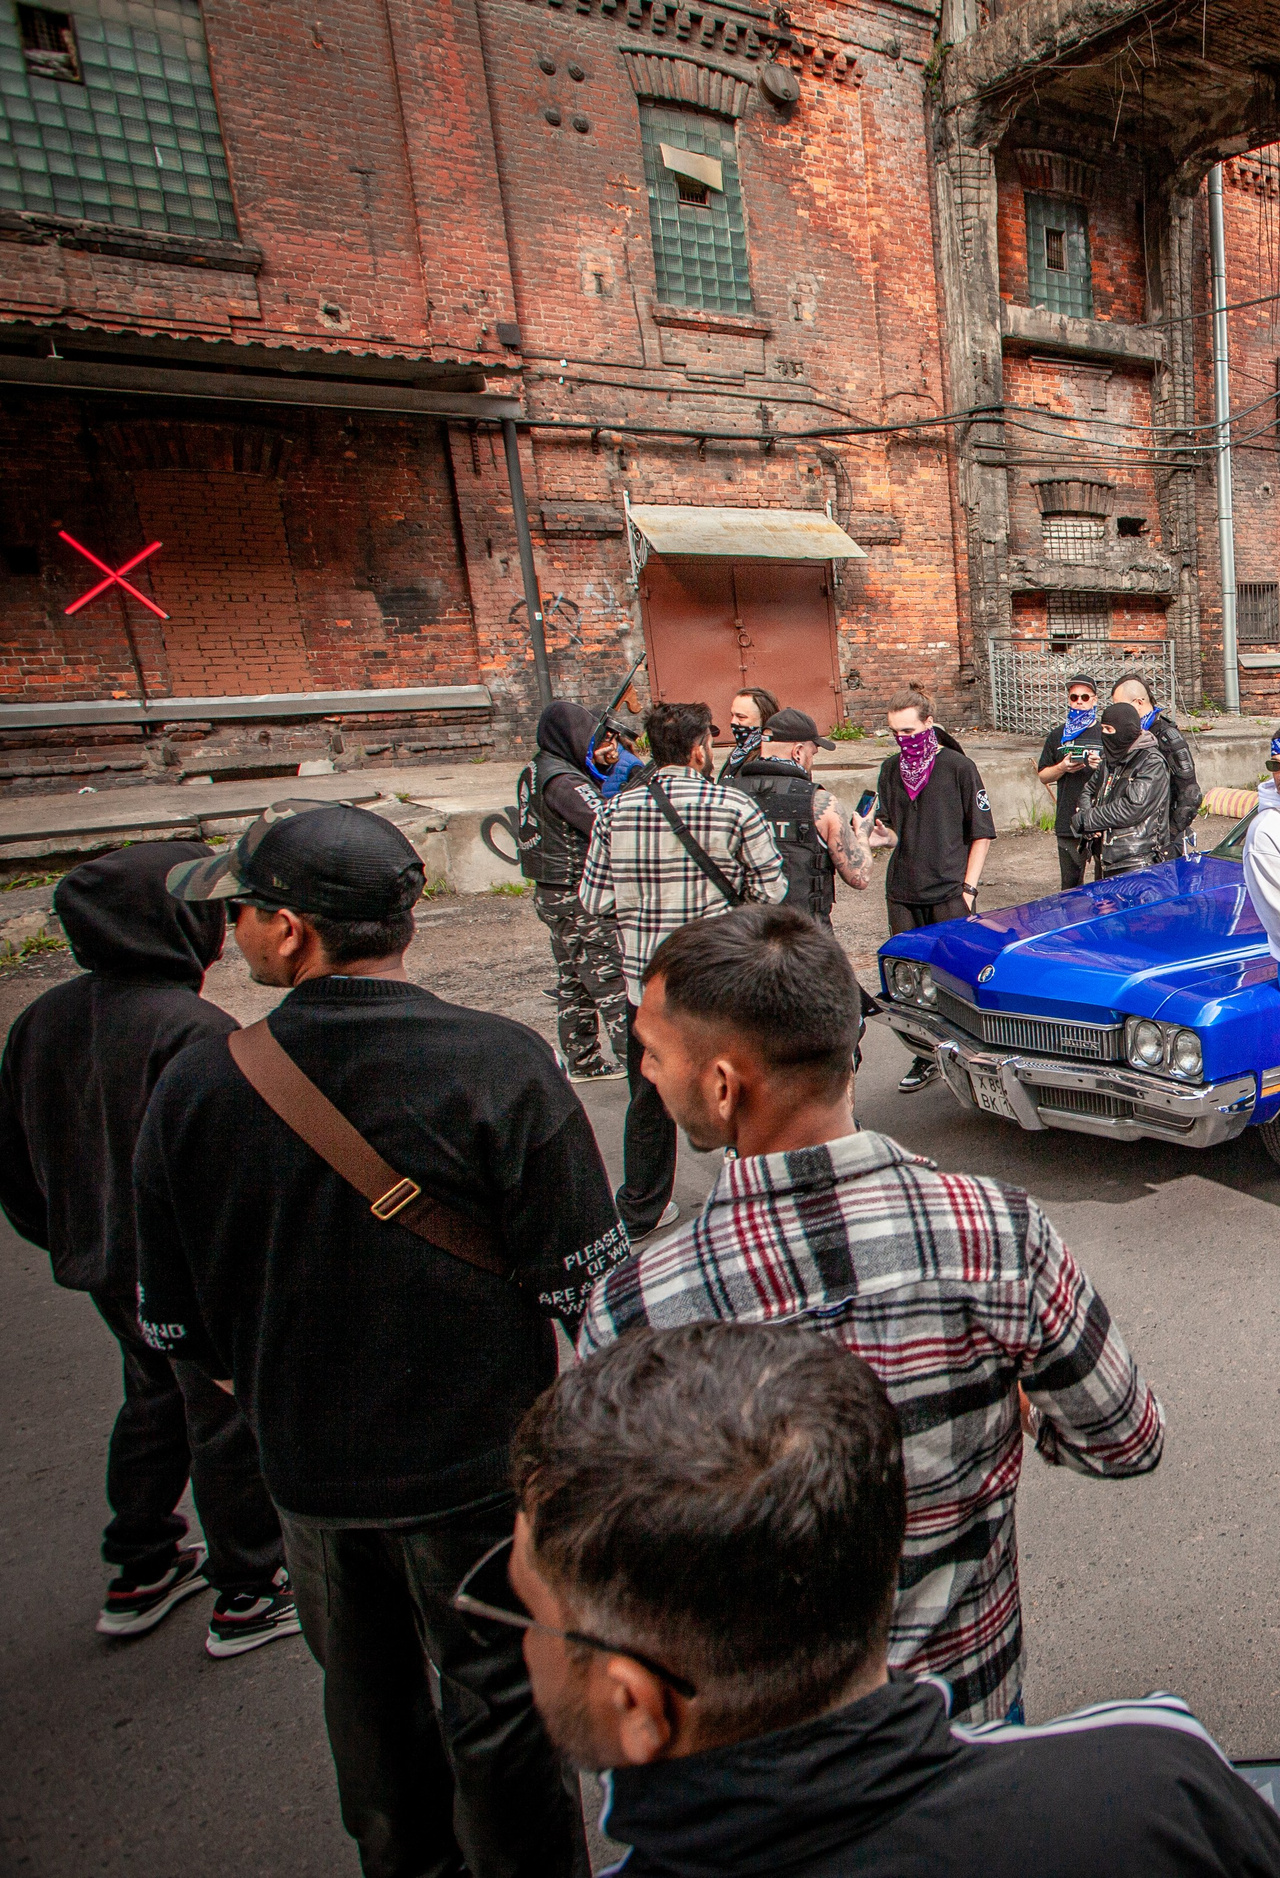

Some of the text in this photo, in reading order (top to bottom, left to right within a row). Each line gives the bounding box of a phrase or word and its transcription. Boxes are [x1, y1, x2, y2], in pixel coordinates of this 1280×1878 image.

[1063, 1038, 1099, 1050] BUICK
[563, 1227, 619, 1271] PLEASE
[586, 1254, 607, 1276] OF
[538, 1286, 576, 1305] ARE
